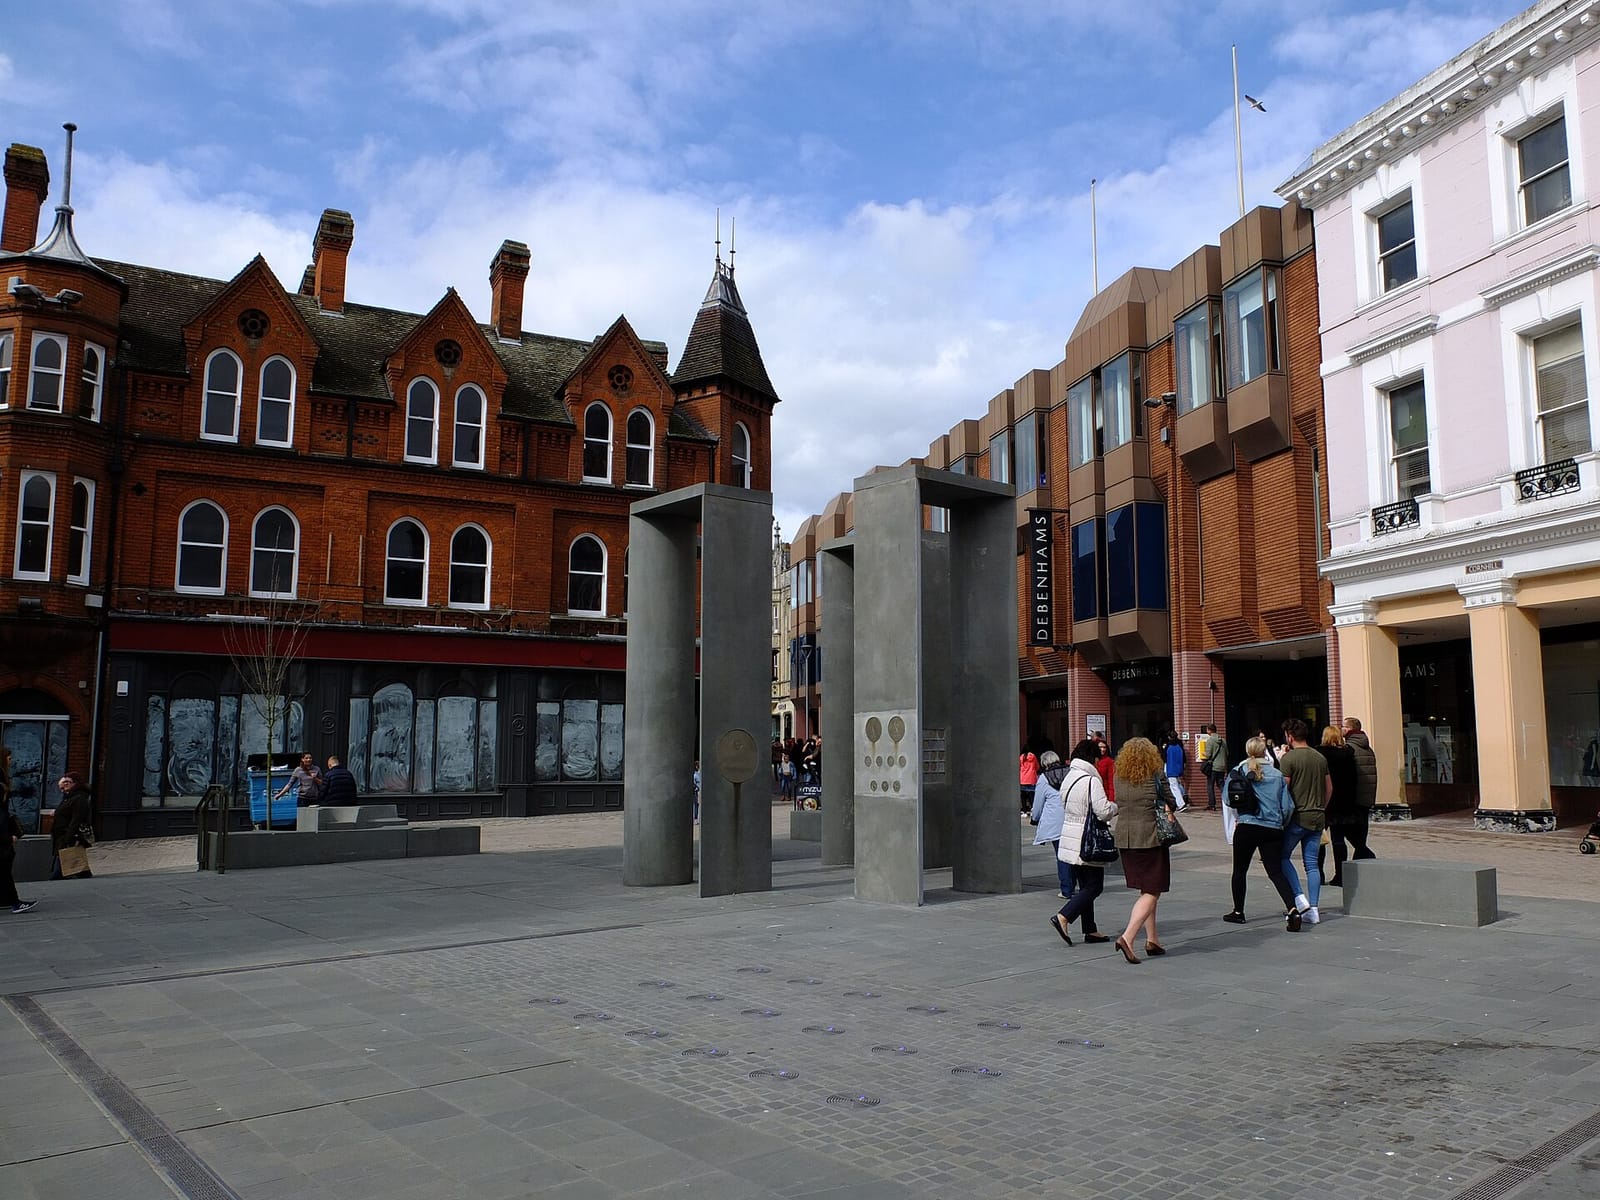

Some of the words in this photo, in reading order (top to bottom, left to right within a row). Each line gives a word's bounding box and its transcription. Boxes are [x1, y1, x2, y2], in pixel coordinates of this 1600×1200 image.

[1468, 561, 1500, 573] CORNHILL
[1035, 515, 1049, 640] DEBENHAMS
[1404, 662, 1436, 678] AMS
